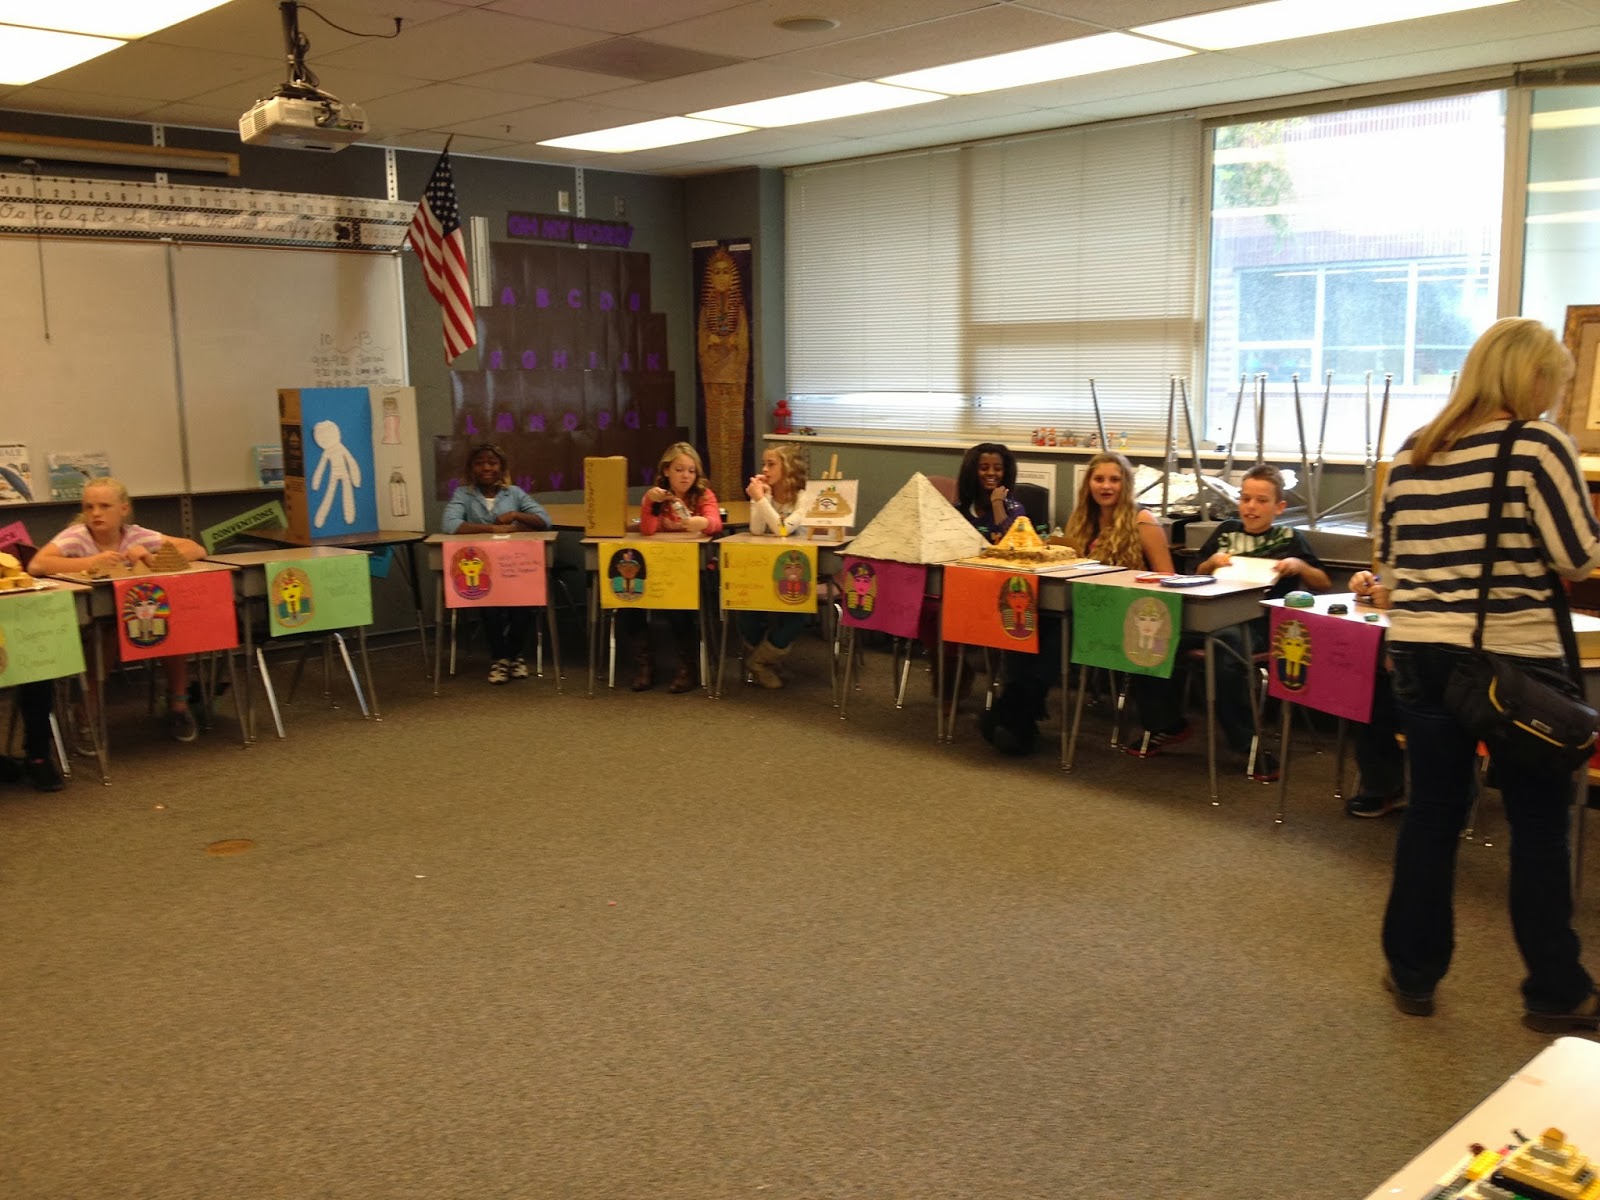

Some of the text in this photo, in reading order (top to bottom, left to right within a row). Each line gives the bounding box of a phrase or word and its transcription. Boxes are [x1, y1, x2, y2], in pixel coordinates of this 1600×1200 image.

[501, 287, 516, 305] A
[536, 288, 549, 308] B
[567, 290, 583, 308] C
[600, 292, 614, 311] D
[553, 351, 568, 369] H
[466, 414, 479, 435] L
[496, 412, 514, 432] M
[563, 412, 578, 431] O
[211, 507, 275, 541] CONVENTIONS
